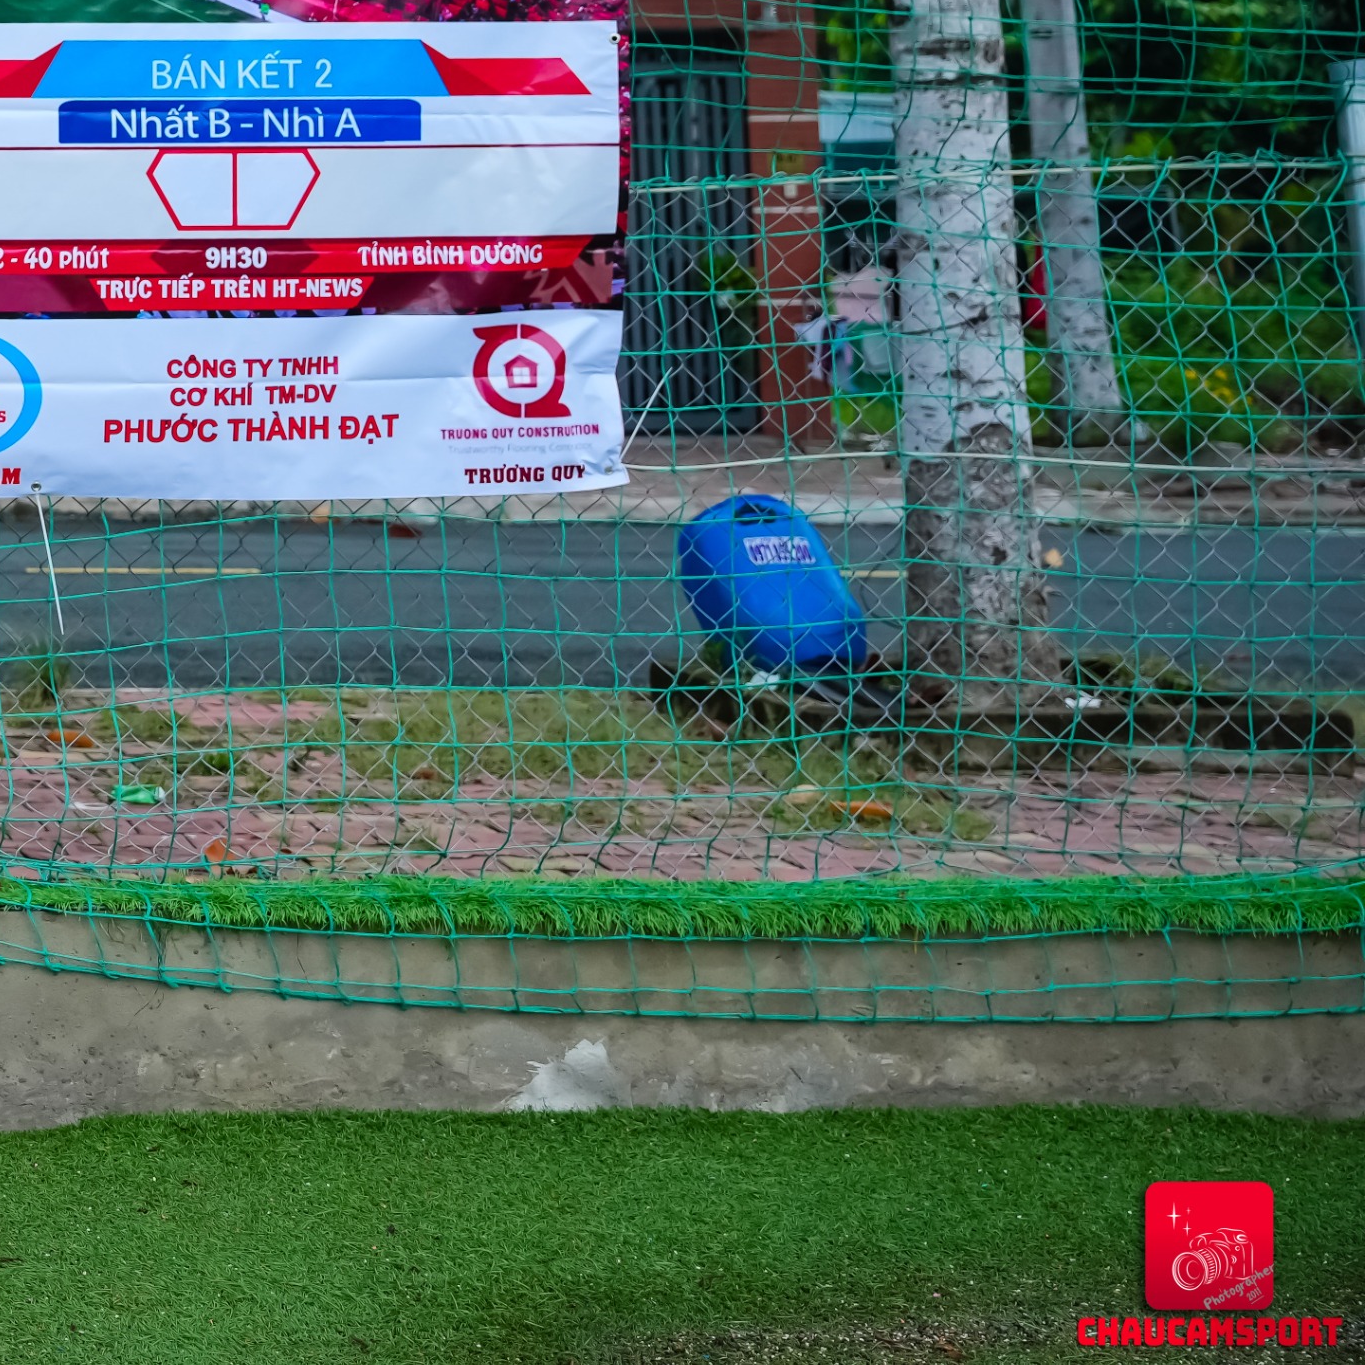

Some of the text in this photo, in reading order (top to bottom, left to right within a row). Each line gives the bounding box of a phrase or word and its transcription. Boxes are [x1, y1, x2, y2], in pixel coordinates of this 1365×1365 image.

[167, 355, 339, 378] CÔNG TY TNHH
[170, 383, 336, 406] CƠ KHÍ TM-DV
[104, 411, 399, 444] PHƯỚC THÀNH ĐẠT
[441, 424, 600, 439] TRUONG QUY CONSTRUCTION
[465, 464, 586, 484] TRƯƠNG QUY
